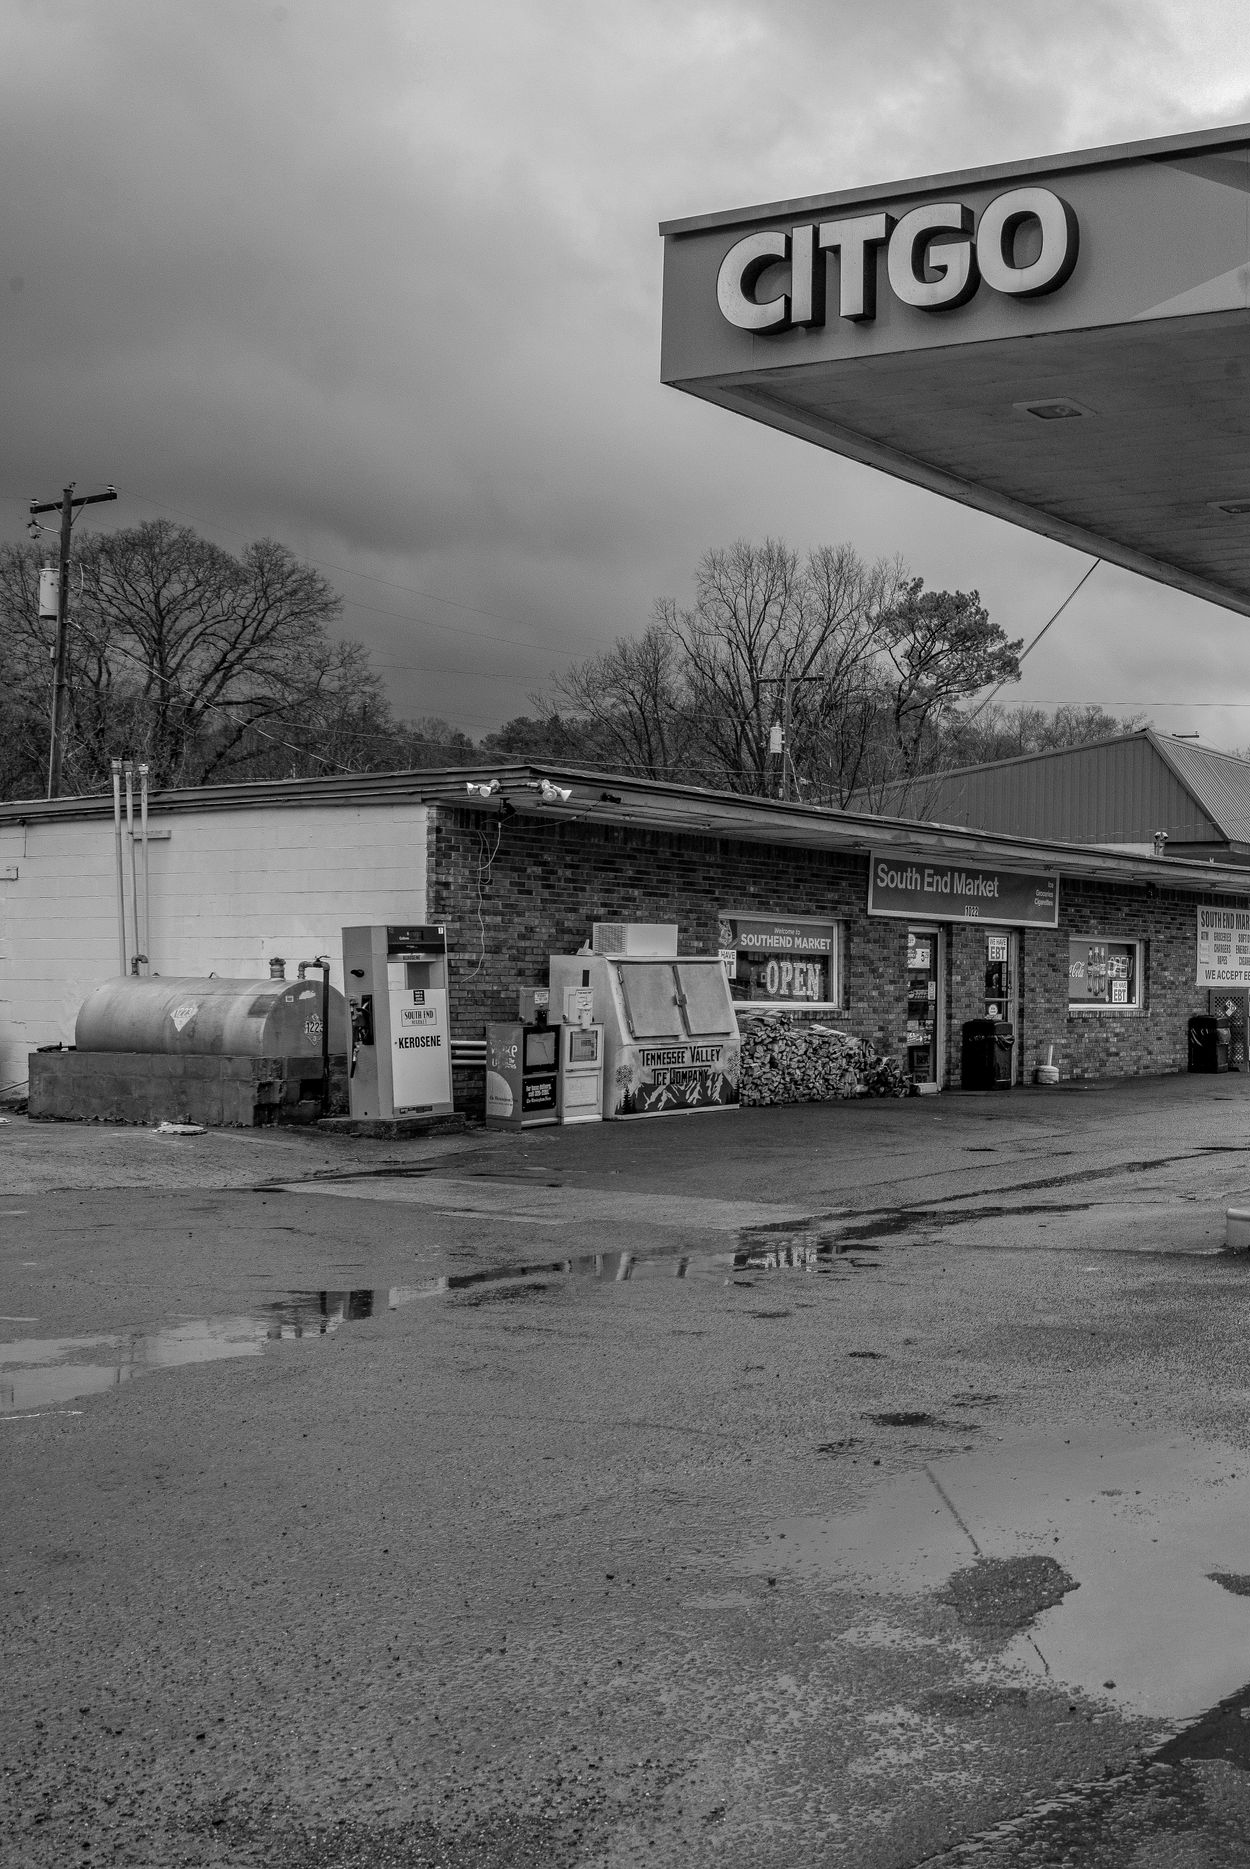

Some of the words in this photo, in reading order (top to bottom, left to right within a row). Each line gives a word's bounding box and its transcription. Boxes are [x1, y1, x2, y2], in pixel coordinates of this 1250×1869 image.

[716, 186, 1076, 333] CITGO
[876, 863, 920, 891] South
[923, 869, 950, 893] End
[953, 873, 1000, 898] Market
[1200, 910, 1221, 929] SOUTH
[1222, 912, 1235, 929] END
[774, 927, 795, 935] Welcome
[741, 933, 793, 948] SOUTHEND
[795, 937, 832, 950] MARKET
[990, 946, 1006, 960] EBT
[766, 960, 821, 1000] OPEN
[1205, 969, 1216, 980] WE
[1217, 970, 1243, 980] ACCEPT
[1114, 988, 1127, 1001] EBT
[404, 1010, 422, 1020] SOUTH
[423, 1010, 434, 1019] END
[306, 1022, 324, 1033] 1223
[398, 1035, 441, 1049] KEROSENE
[639, 1047, 688, 1066] TENNESSEE
[689, 1045, 723, 1063] VALLEY
[652, 1068, 669, 1086] ICE
[669, 1065, 712, 1085] COMPANY
